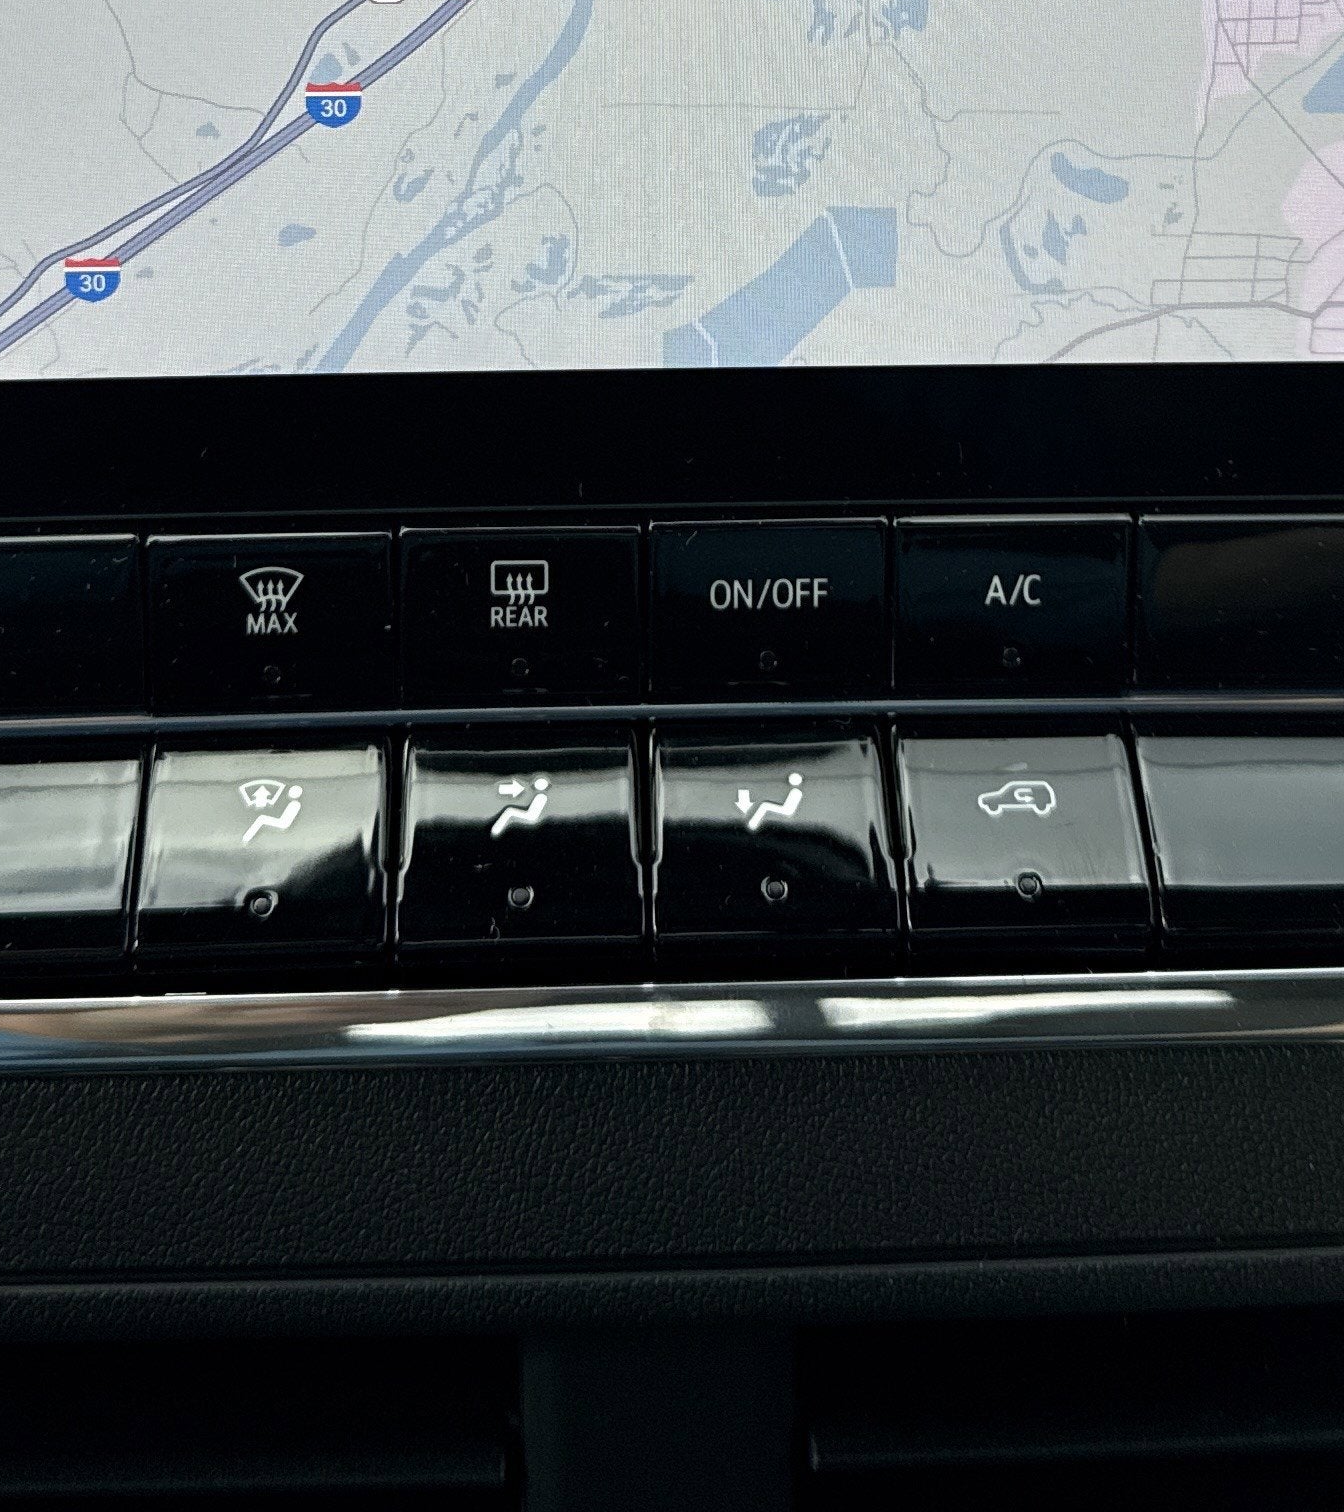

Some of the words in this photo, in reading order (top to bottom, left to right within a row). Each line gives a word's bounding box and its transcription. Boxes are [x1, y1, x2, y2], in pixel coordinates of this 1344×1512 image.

[320, 99, 348, 119] 30
[79, 274, 107, 294] 30
[709, 577, 829, 610] ON/OFF
[984, 574, 1042, 606] A/C
[245, 613, 299, 635] MAX
[489, 605, 549, 628] REAR
